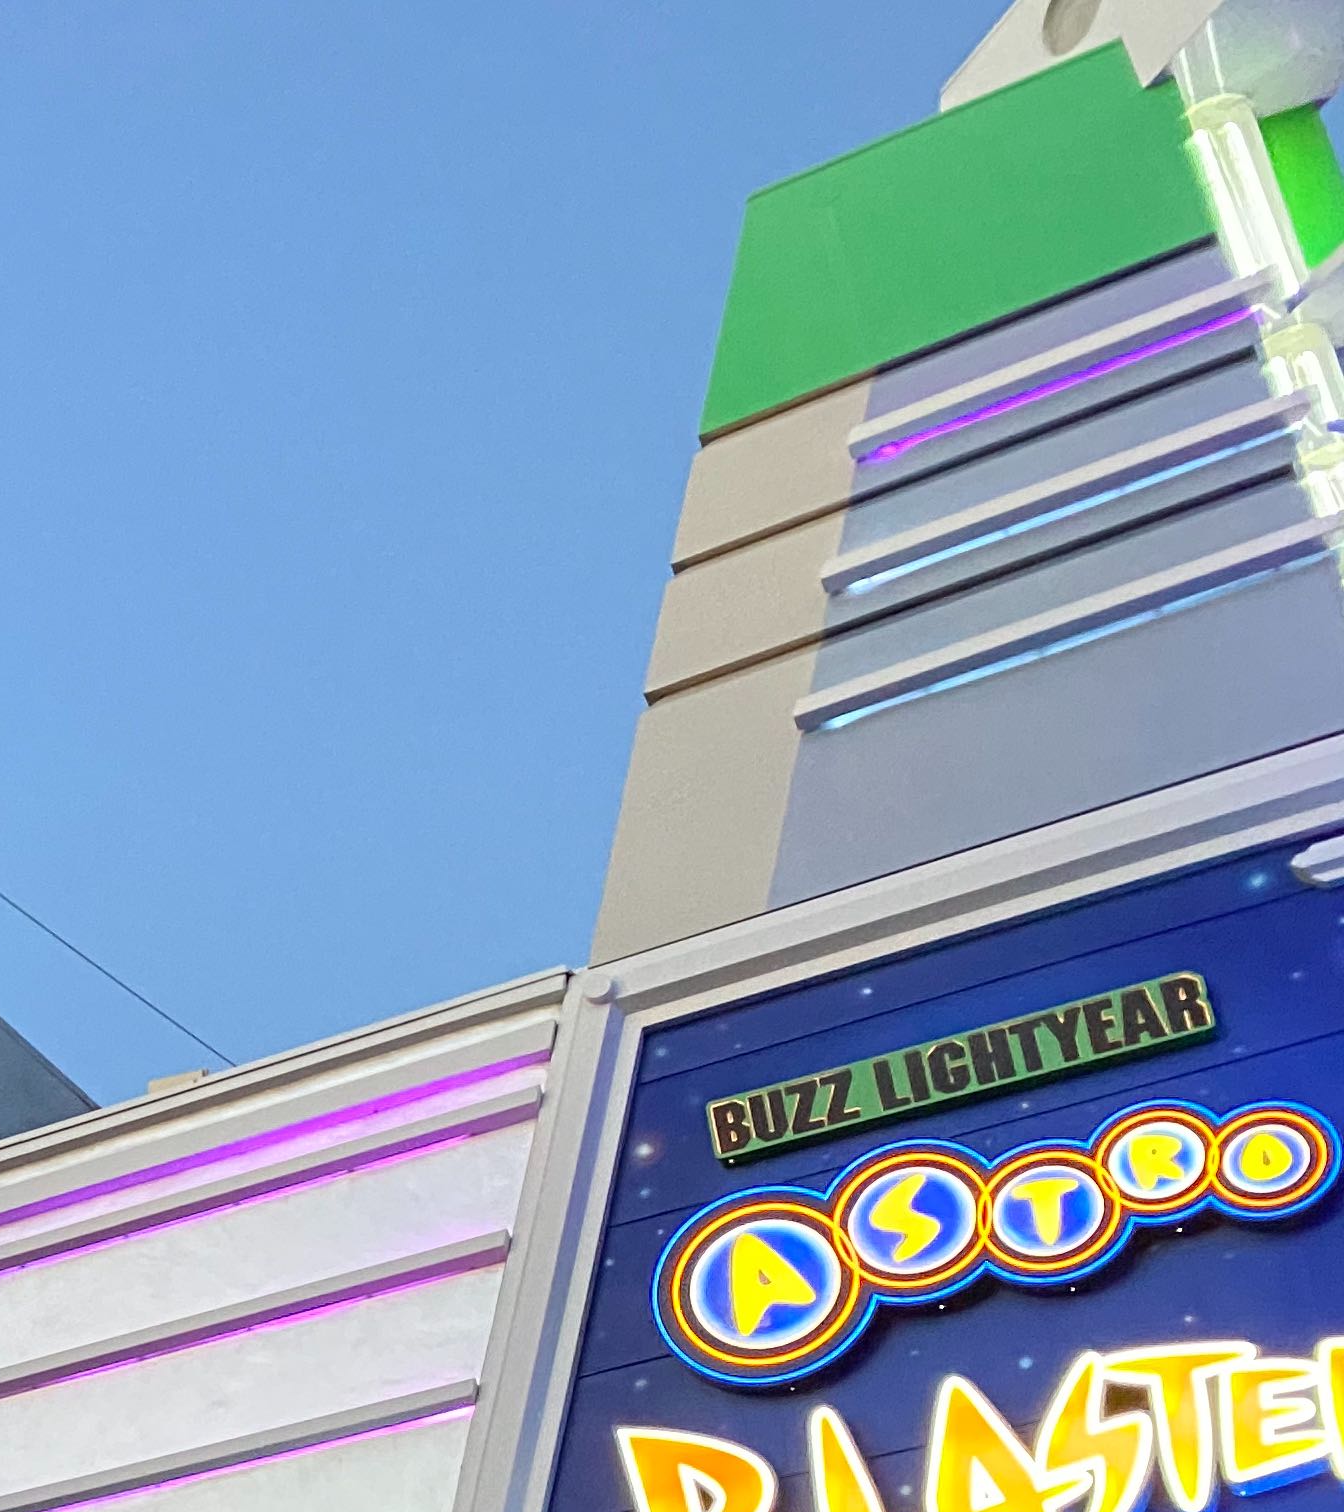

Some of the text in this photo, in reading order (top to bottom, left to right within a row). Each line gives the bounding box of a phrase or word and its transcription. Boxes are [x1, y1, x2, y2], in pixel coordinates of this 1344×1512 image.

[711, 973, 1214, 1155] BUZZ LIGHTYEAR
[727, 1131, 1296, 1339] ASTRO
